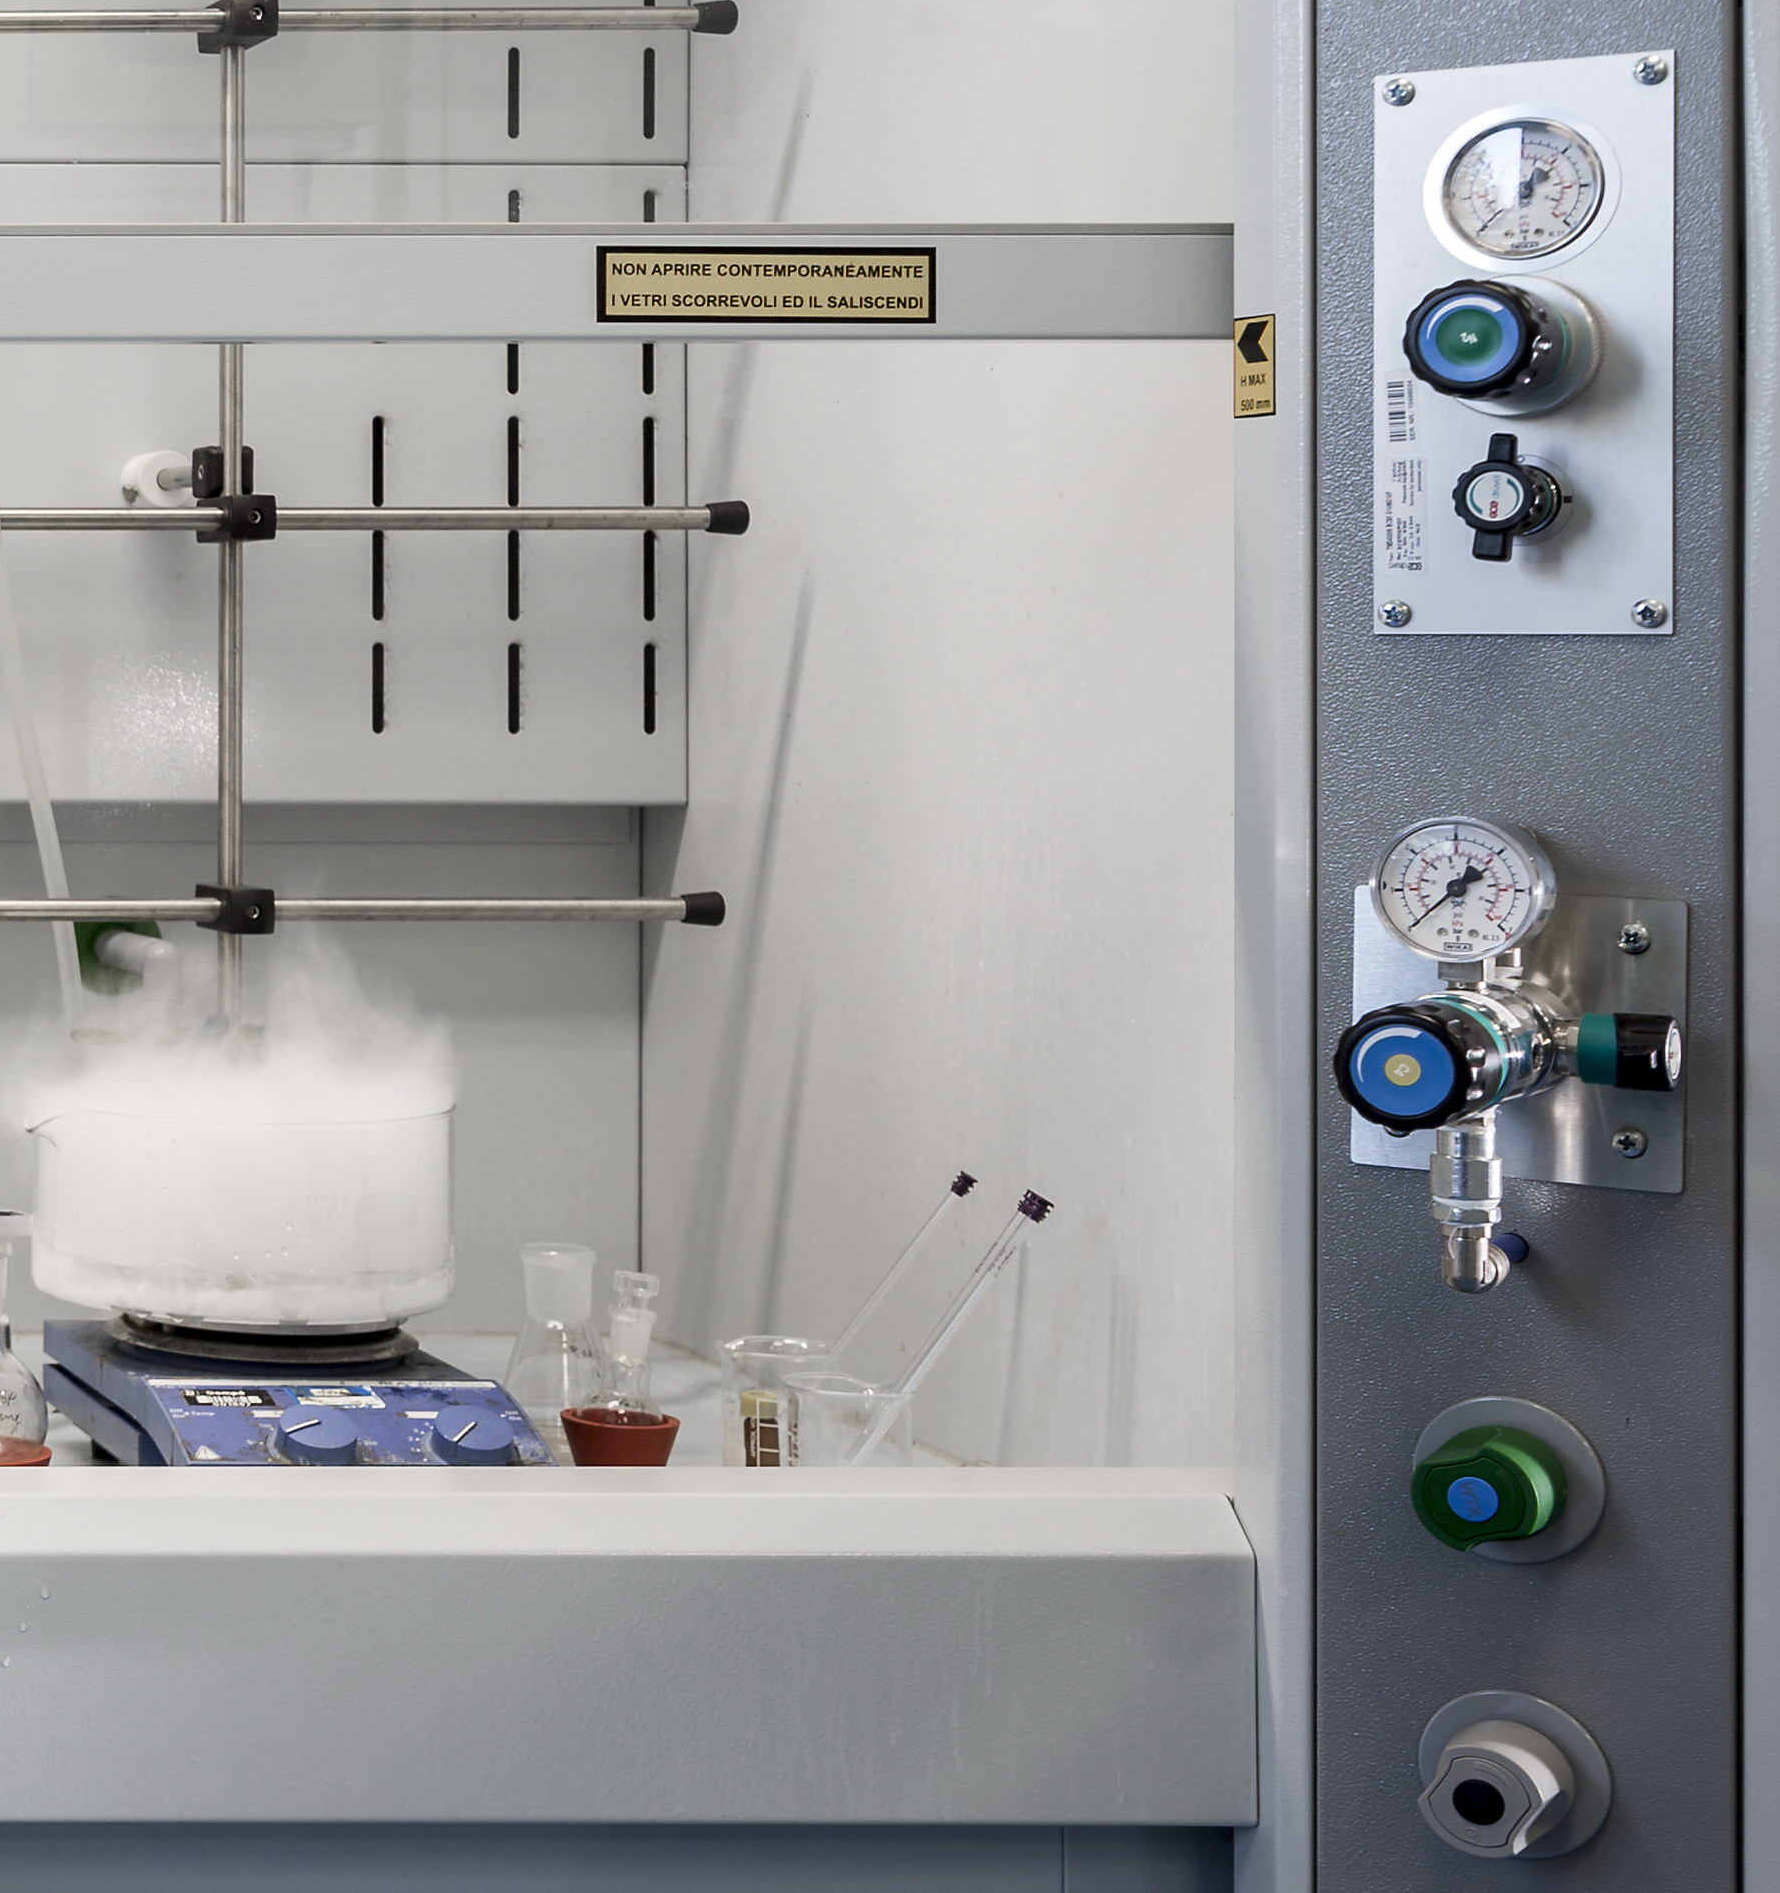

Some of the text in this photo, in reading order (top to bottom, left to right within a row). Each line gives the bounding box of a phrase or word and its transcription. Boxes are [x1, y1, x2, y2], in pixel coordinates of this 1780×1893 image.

[613, 263, 646, 275] NON
[651, 264, 711, 276] APRIRE
[612, 294, 923, 309] I VETRI SCORREVOLI ED IL SALISCENDI
[1240, 373, 1266, 387] H MAX
[1241, 398, 1270, 411] 500 mm
